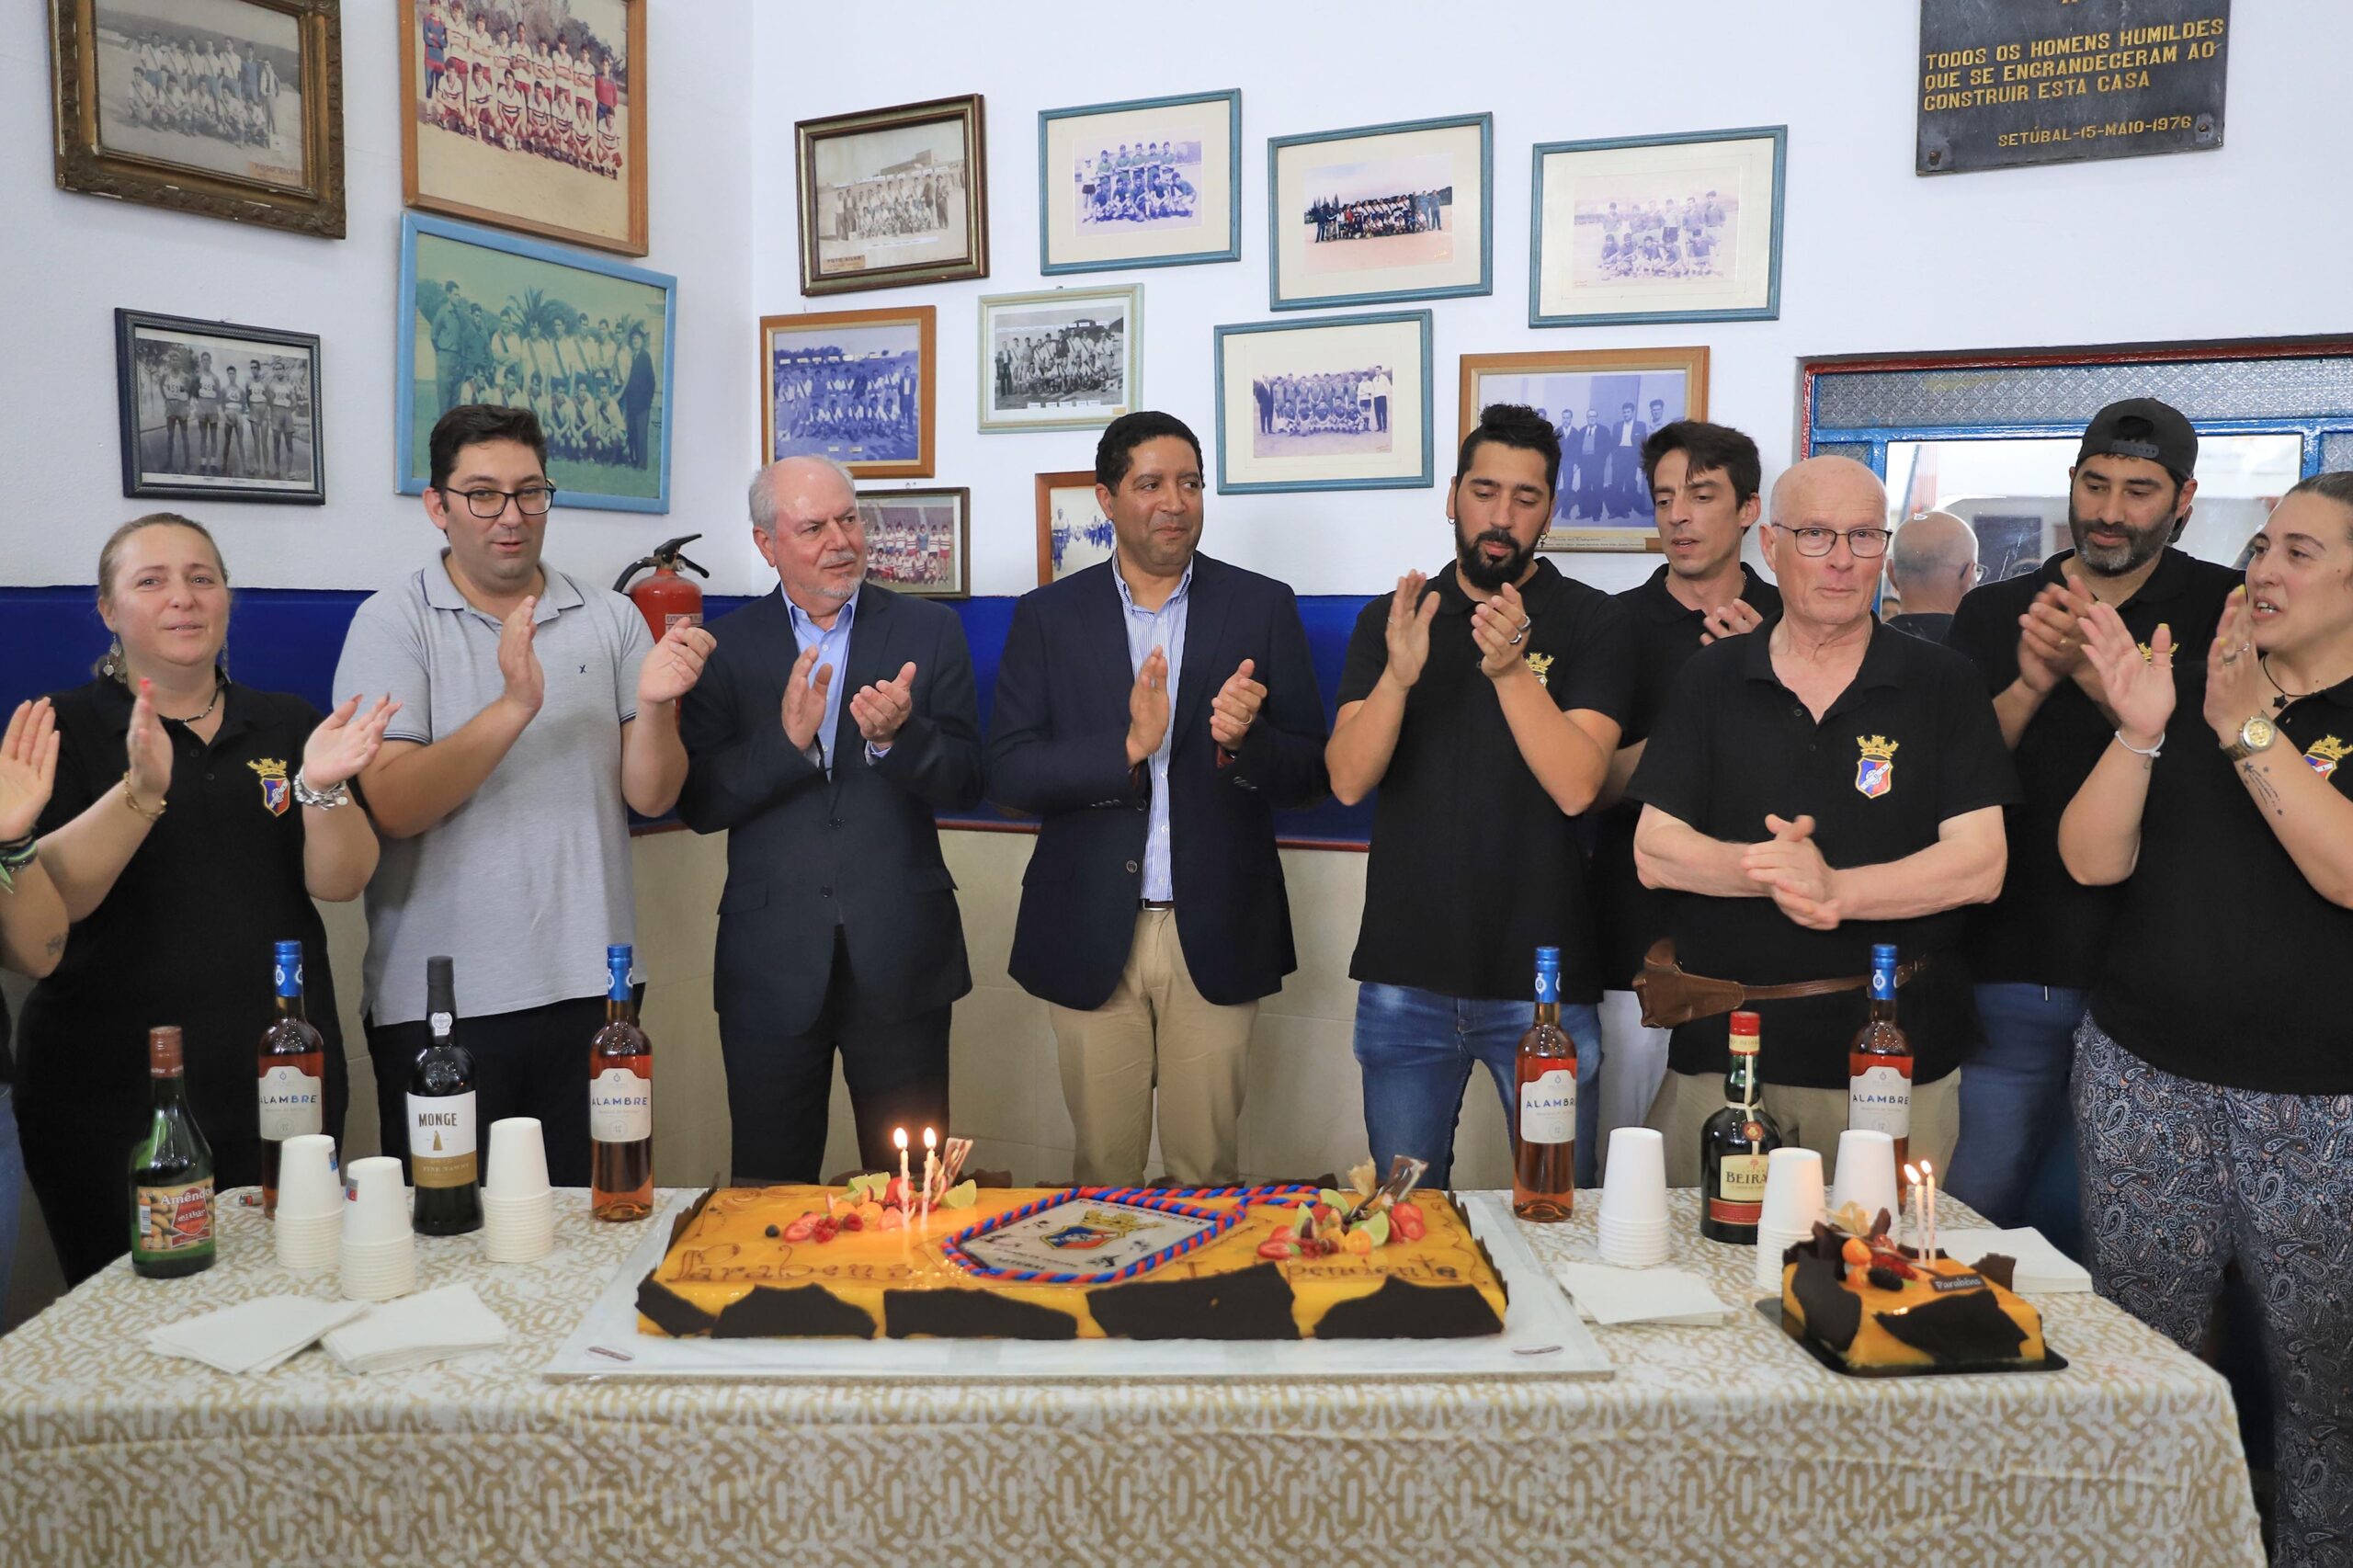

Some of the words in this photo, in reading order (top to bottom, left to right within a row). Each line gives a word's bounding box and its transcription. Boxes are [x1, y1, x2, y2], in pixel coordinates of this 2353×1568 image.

[1926, 47, 1987, 70] TODOS
[1995, 44, 2021, 62] OS
[2030, 32, 2110, 58] HOMENS
[2120, 18, 2224, 47] HUMILDES
[1925, 71, 1961, 93] QUE
[1970, 67, 1995, 85] SE
[2003, 45, 2177, 82] ENGRANDECERAM
[2188, 40, 2216, 61] AO
[1924, 85, 2029, 111] CONSTRUIR
[2038, 77, 2086, 99] ESTA
[2097, 71, 2151, 93] CASA
[591, 1096, 648, 1106] ALAMBRE
[1526, 1097, 1575, 1108] ALAMBR
[1852, 1094, 1909, 1105] ALAMBRE
[418, 1113, 458, 1127] MONGE
